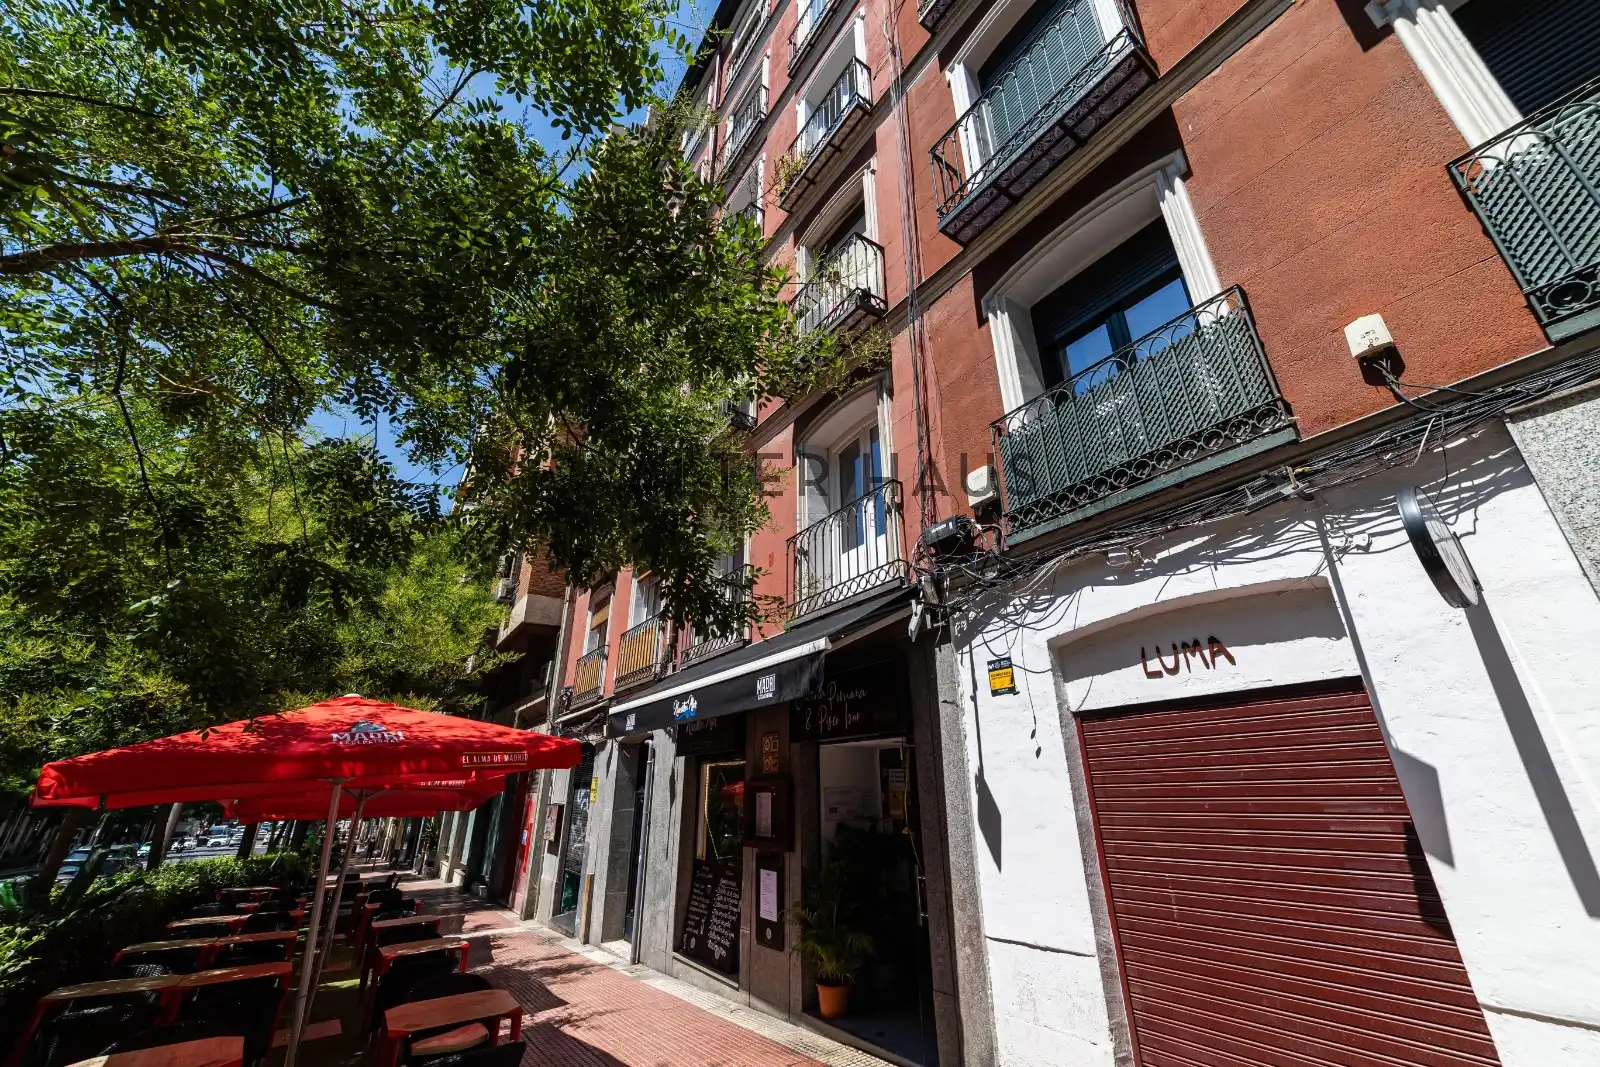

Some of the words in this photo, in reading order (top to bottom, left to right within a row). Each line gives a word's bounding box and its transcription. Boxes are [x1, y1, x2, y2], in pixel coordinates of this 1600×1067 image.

[1141, 636, 1236, 679] LUMA
[462, 755, 469, 764] EL
[473, 755, 491, 763] ALMA
[493, 754, 501, 763] DE
[503, 752, 529, 762] MADRID
